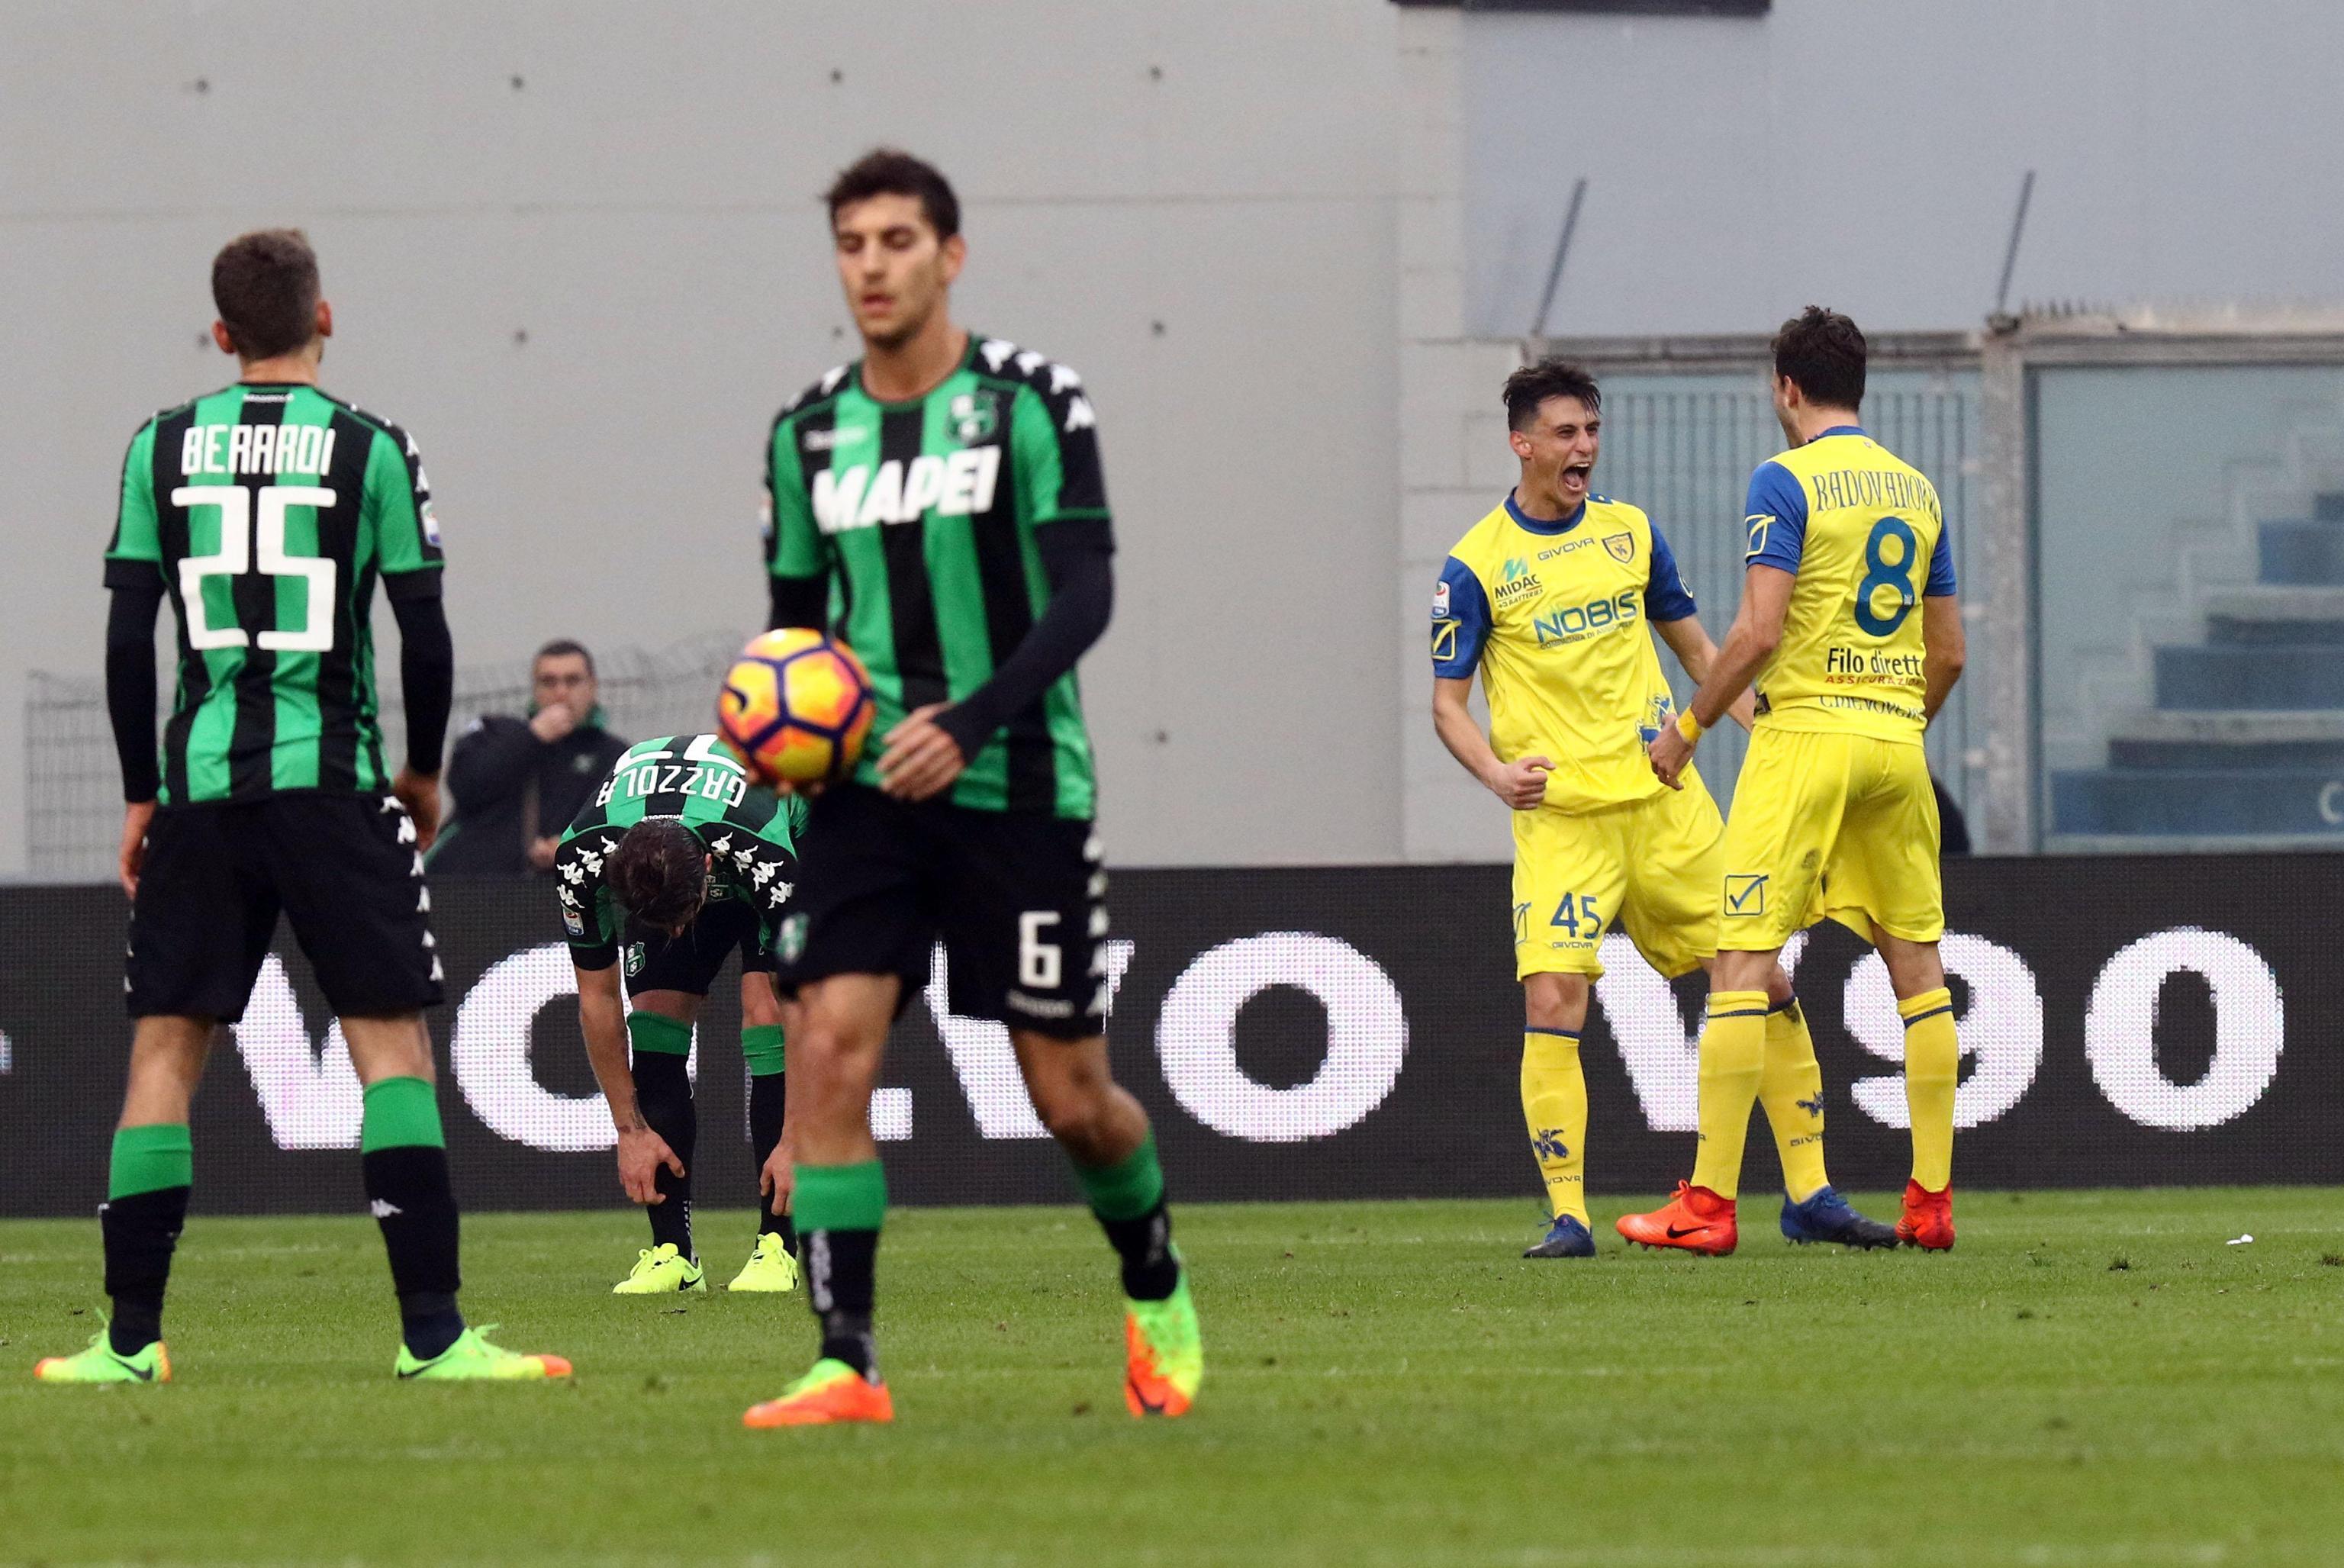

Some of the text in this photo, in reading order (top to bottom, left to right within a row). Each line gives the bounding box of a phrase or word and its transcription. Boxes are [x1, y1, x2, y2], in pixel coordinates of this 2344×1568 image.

[181, 424, 336, 475] BERARDI
[812, 445, 1001, 534] MAPEI
[171, 486, 336, 652] 25
[1537, 537, 1595, 561] GIVOVA
[1495, 574, 1541, 599] MIDAC
[1509, 588, 1543, 605] BATTERIES
[1855, 516, 1916, 636] 8
[1534, 592, 1637, 643] NOBIS
[1827, 648, 1921, 676] Filo dirett
[595, 765, 746, 809] GAZZOLA
[1550, 892, 1602, 939] 45
[1019, 910, 1061, 988] 6
